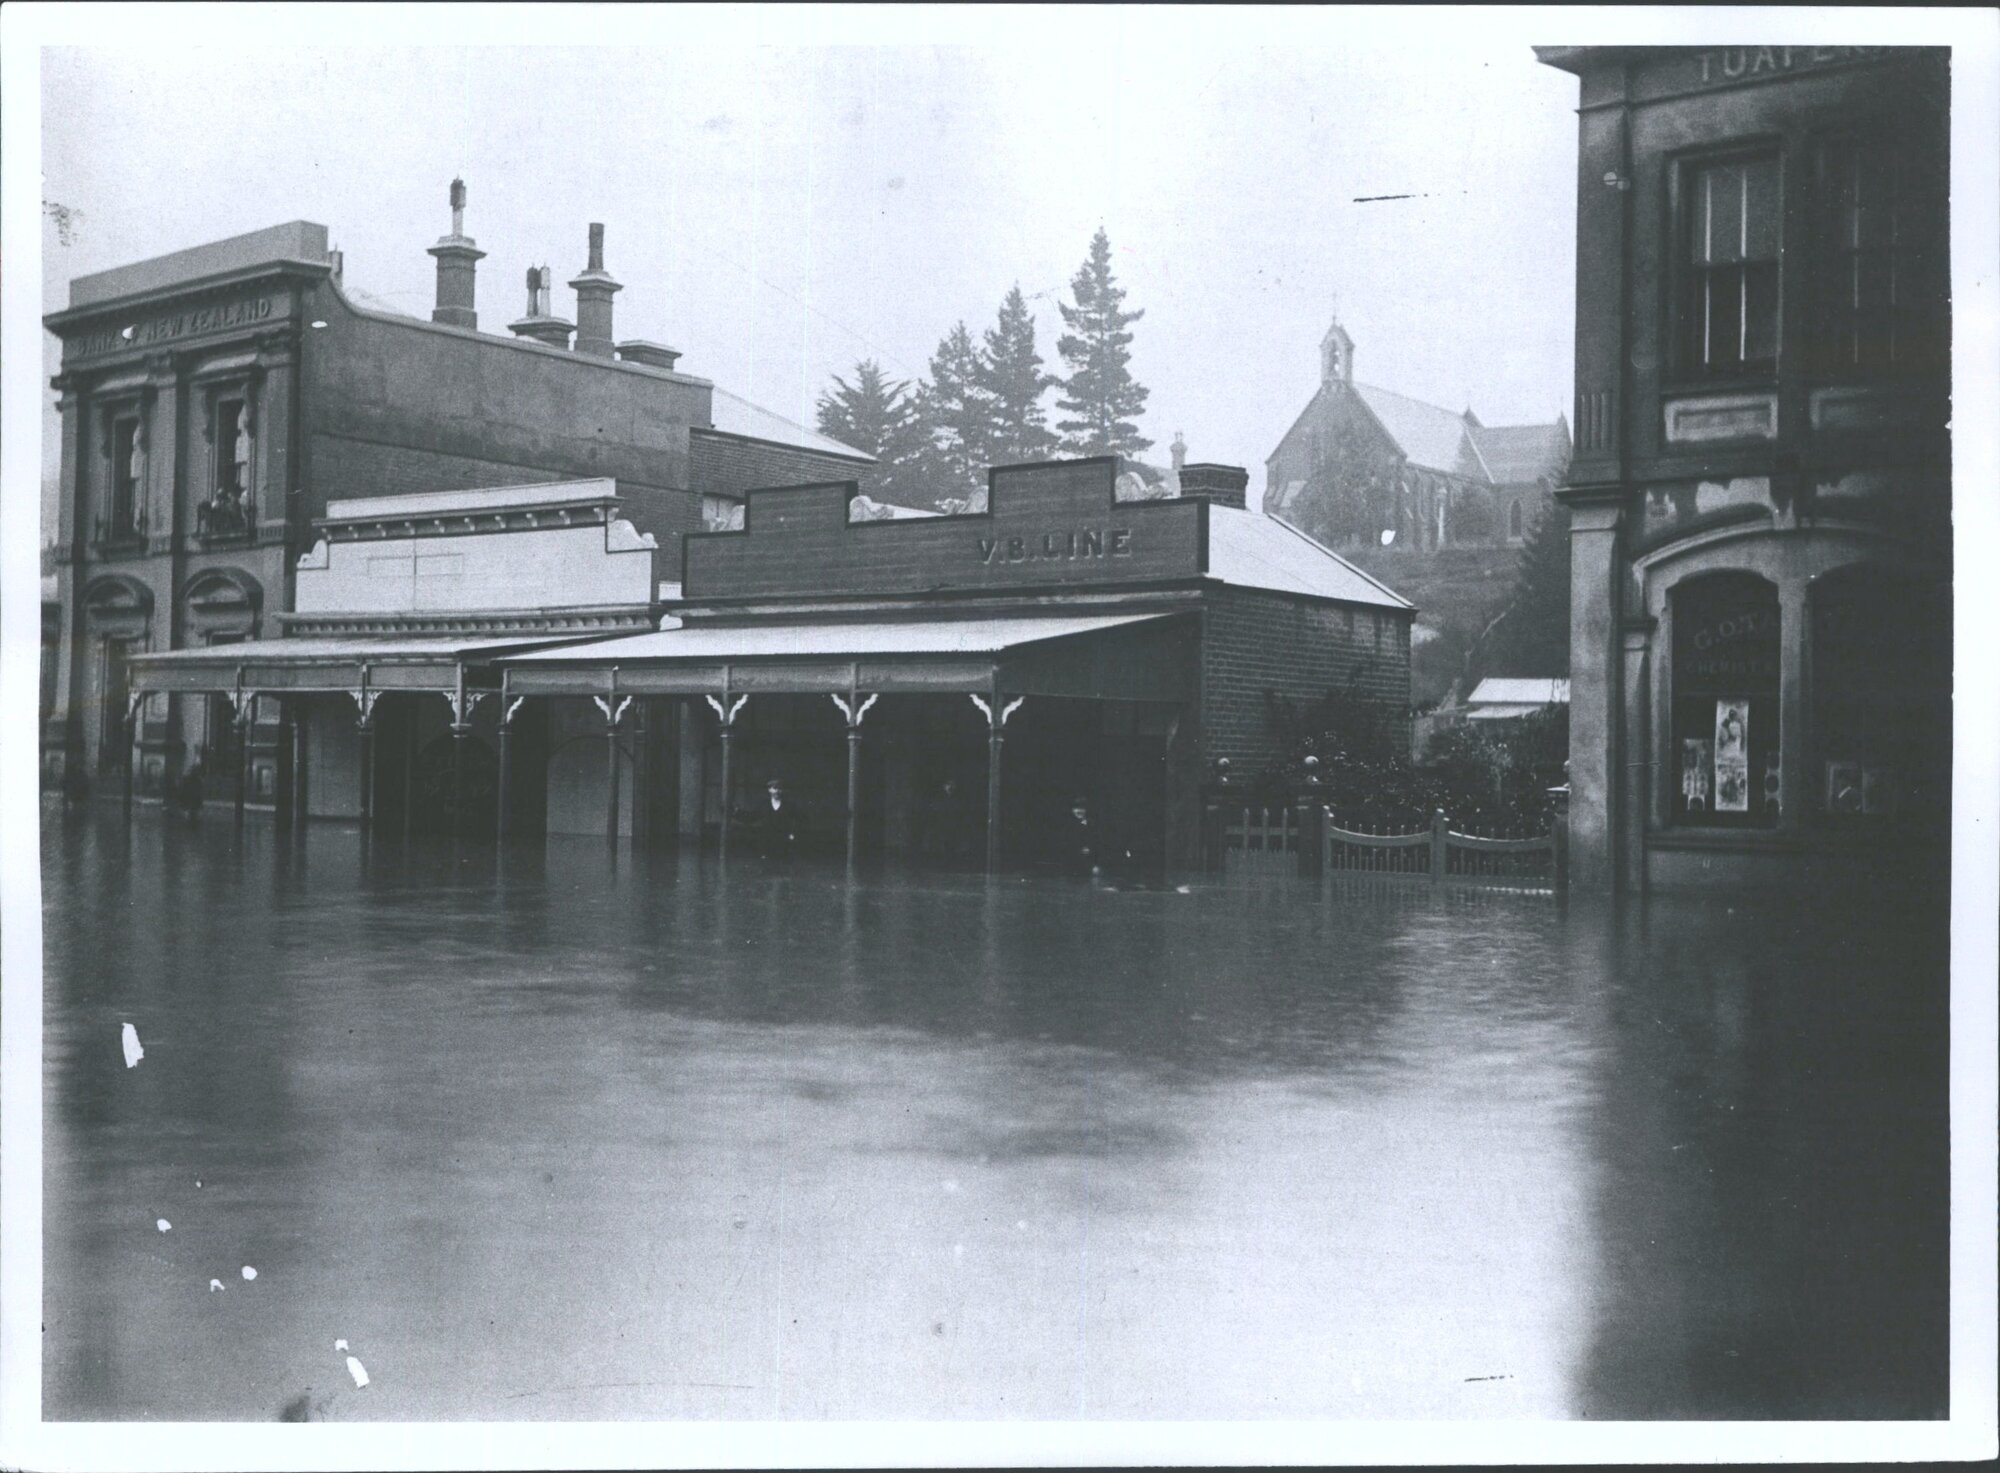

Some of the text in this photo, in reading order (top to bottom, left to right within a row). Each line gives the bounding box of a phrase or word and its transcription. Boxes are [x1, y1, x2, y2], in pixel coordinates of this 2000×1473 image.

[79, 332, 117, 355] BANK
[147, 314, 182, 338] NEW
[190, 297, 271, 329] ZEALAND
[1685, 660, 1759, 675] CHEMIST
